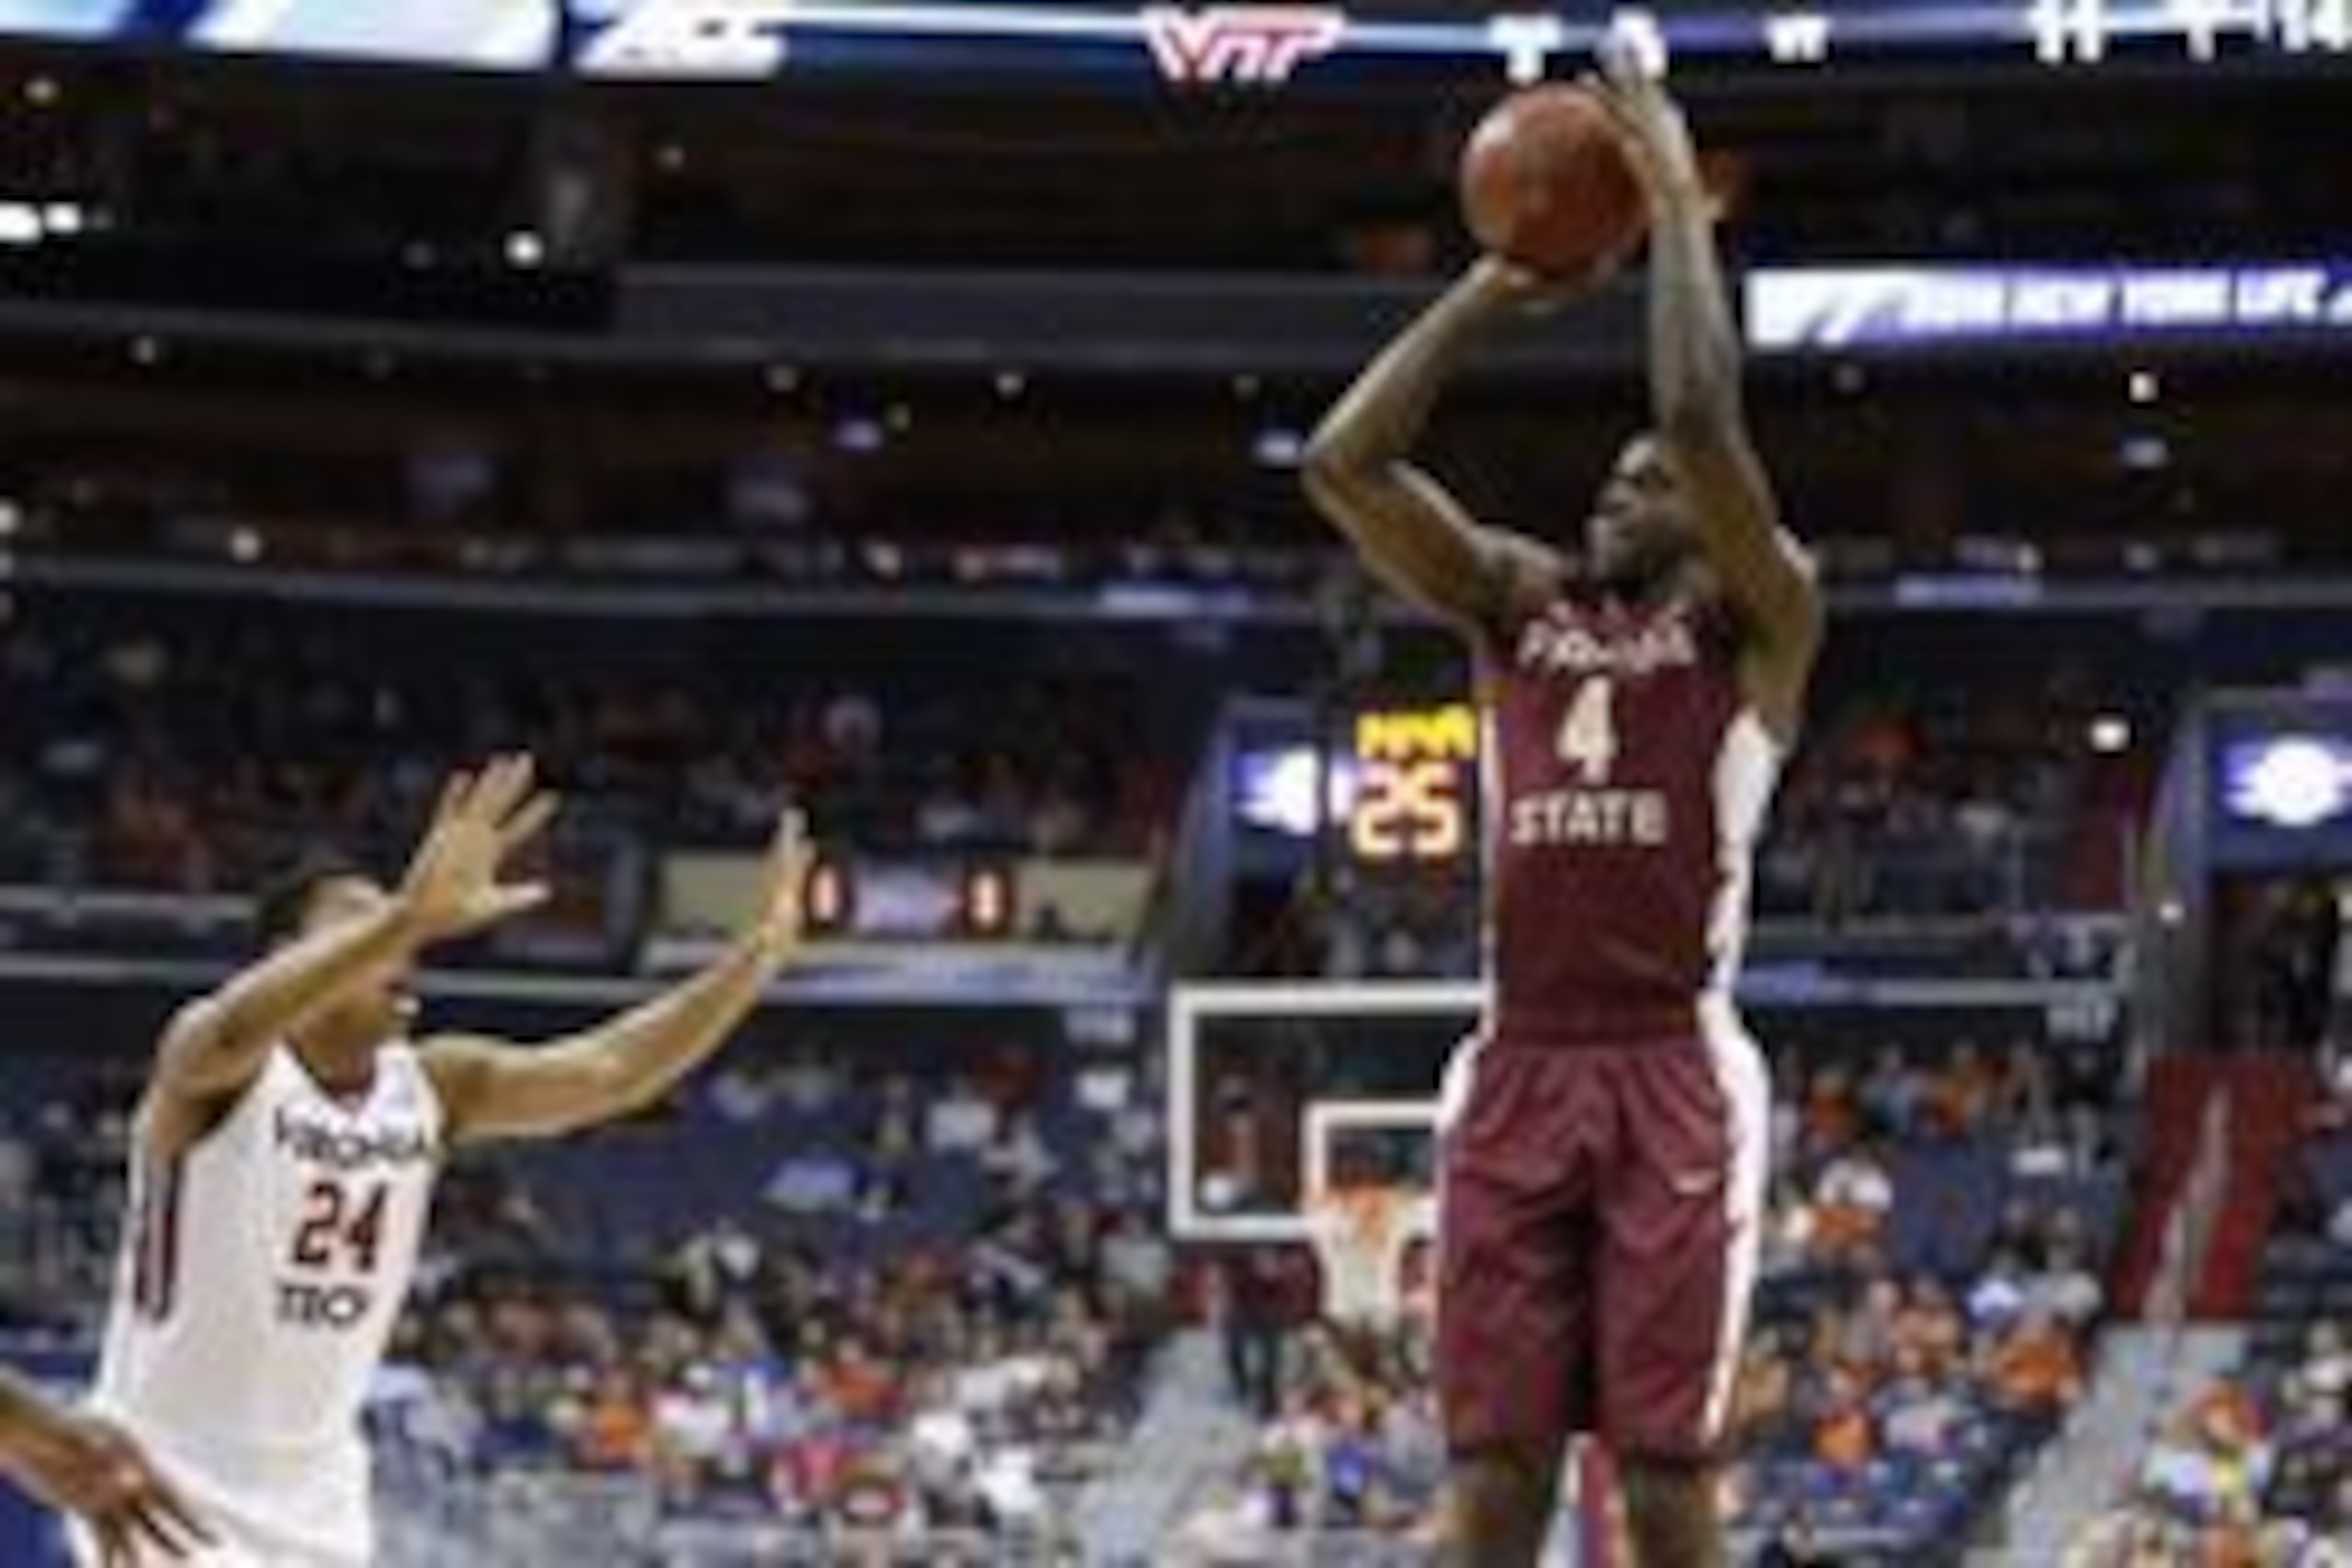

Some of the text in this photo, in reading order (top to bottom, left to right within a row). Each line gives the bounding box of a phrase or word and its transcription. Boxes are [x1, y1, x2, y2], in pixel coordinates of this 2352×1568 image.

[1556, 677, 1620, 782] 4
[1356, 761, 1460, 854] 25
[1509, 790, 1668, 847] STATE
[292, 1179, 390, 1271] 24
